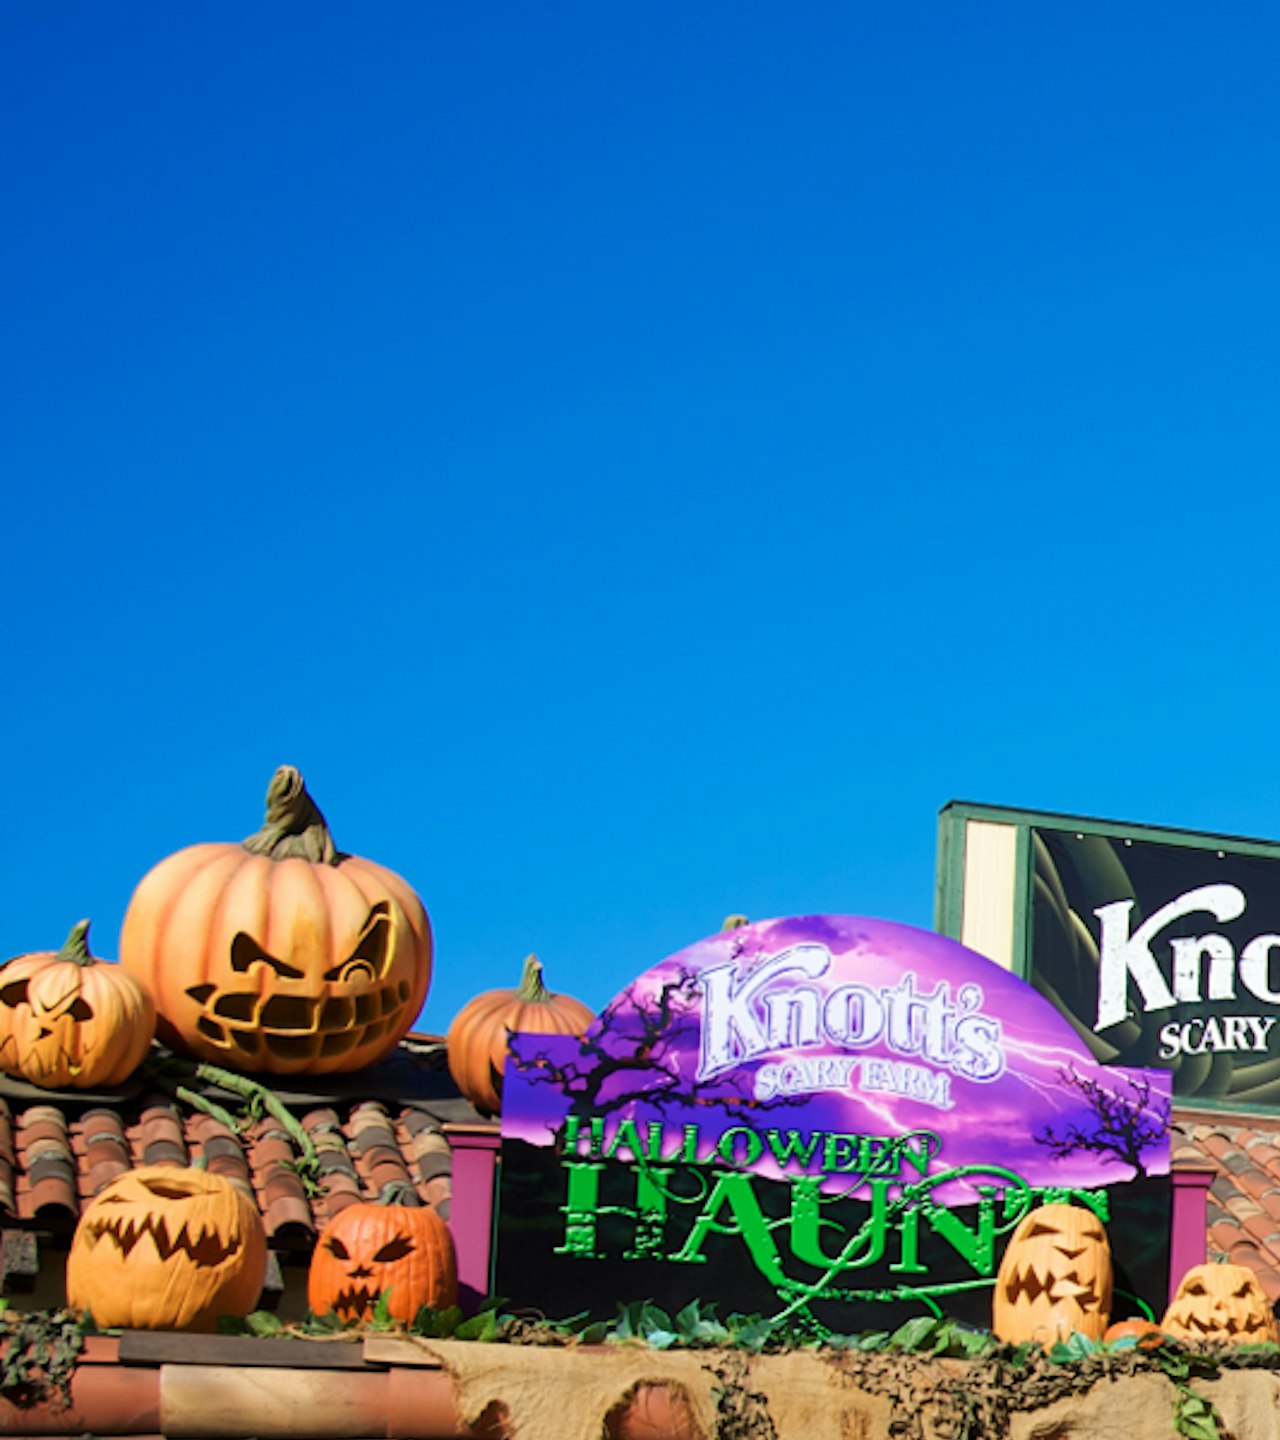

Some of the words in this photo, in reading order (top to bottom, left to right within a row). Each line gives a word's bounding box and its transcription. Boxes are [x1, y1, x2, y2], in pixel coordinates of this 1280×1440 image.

[696, 942, 1006, 1083] Knott's
[1158, 1015, 1278, 1060] SCARY
[753, 1056, 855, 1101] SCARY
[859, 1056, 956, 1111] FARM
[560, 1113, 940, 1176] HALLOWEEN
